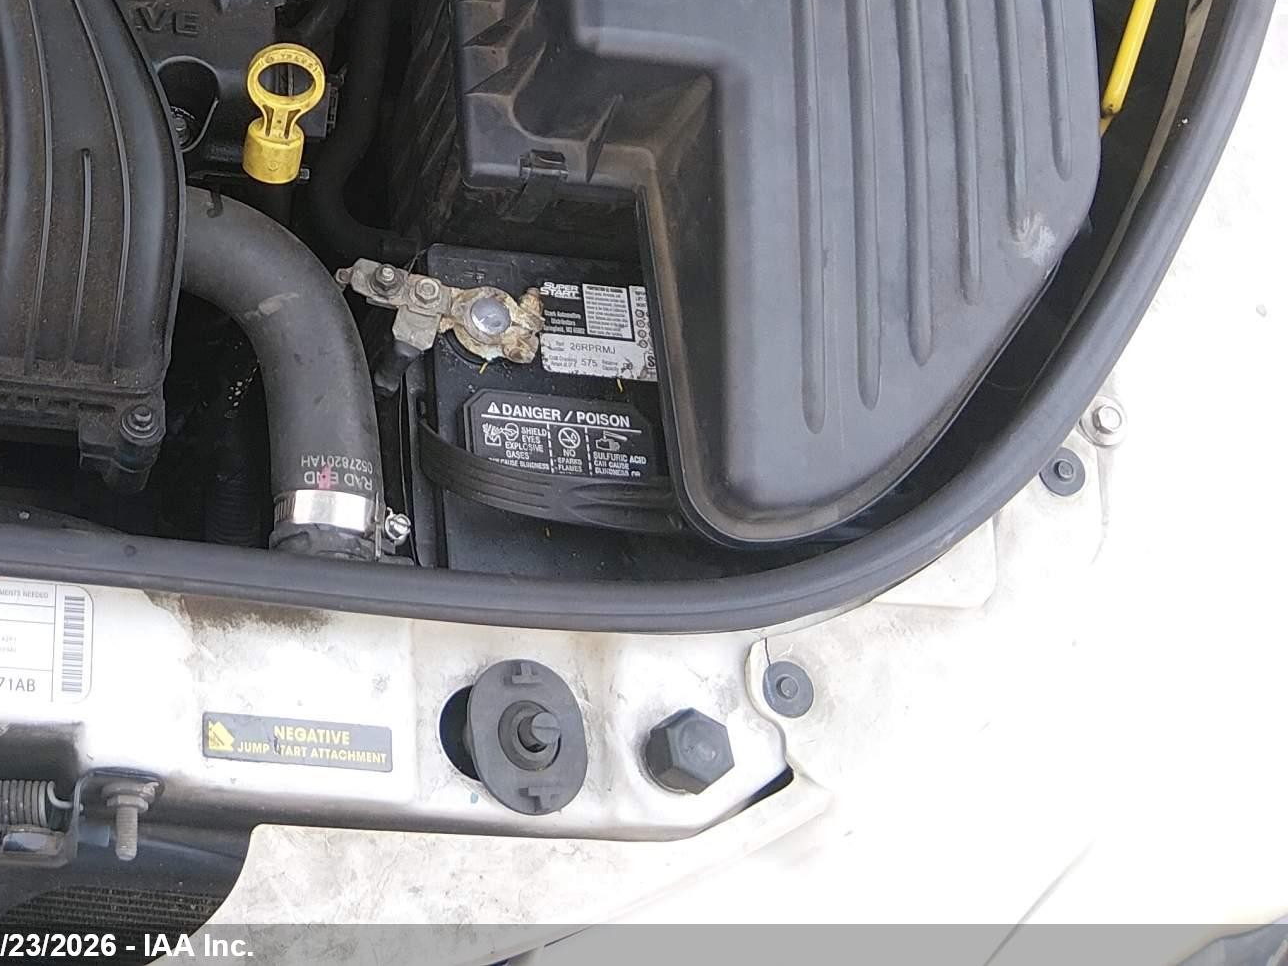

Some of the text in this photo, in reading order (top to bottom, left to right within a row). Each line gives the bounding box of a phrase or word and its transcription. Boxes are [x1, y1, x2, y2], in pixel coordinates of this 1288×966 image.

[543, 281, 579, 292] SUPER
[569, 342, 616, 354] 26RPRMJ
[581, 358, 598, 367] 575
[502, 403, 631, 428] DANGER / POISON
[520, 426, 548, 437] SHIELD
[521, 434, 541, 444] EYES
[504, 441, 544, 453] EXPLOSIVE
[562, 448, 576, 457] NO
[505, 450, 530, 460] GASES
[592, 450, 647, 465] SULFURIC ACID
[301, 454, 373, 474] 05278201AH
[608, 461, 630, 470] CAUSE
[343, 472, 373, 491] RAD
[22, 590, 49, 599] NEEDED
[273, 725, 350, 746] NEGATIVE
[237, 741, 270, 755] JUMP
[309, 746, 387, 764] ATTACHMENT
